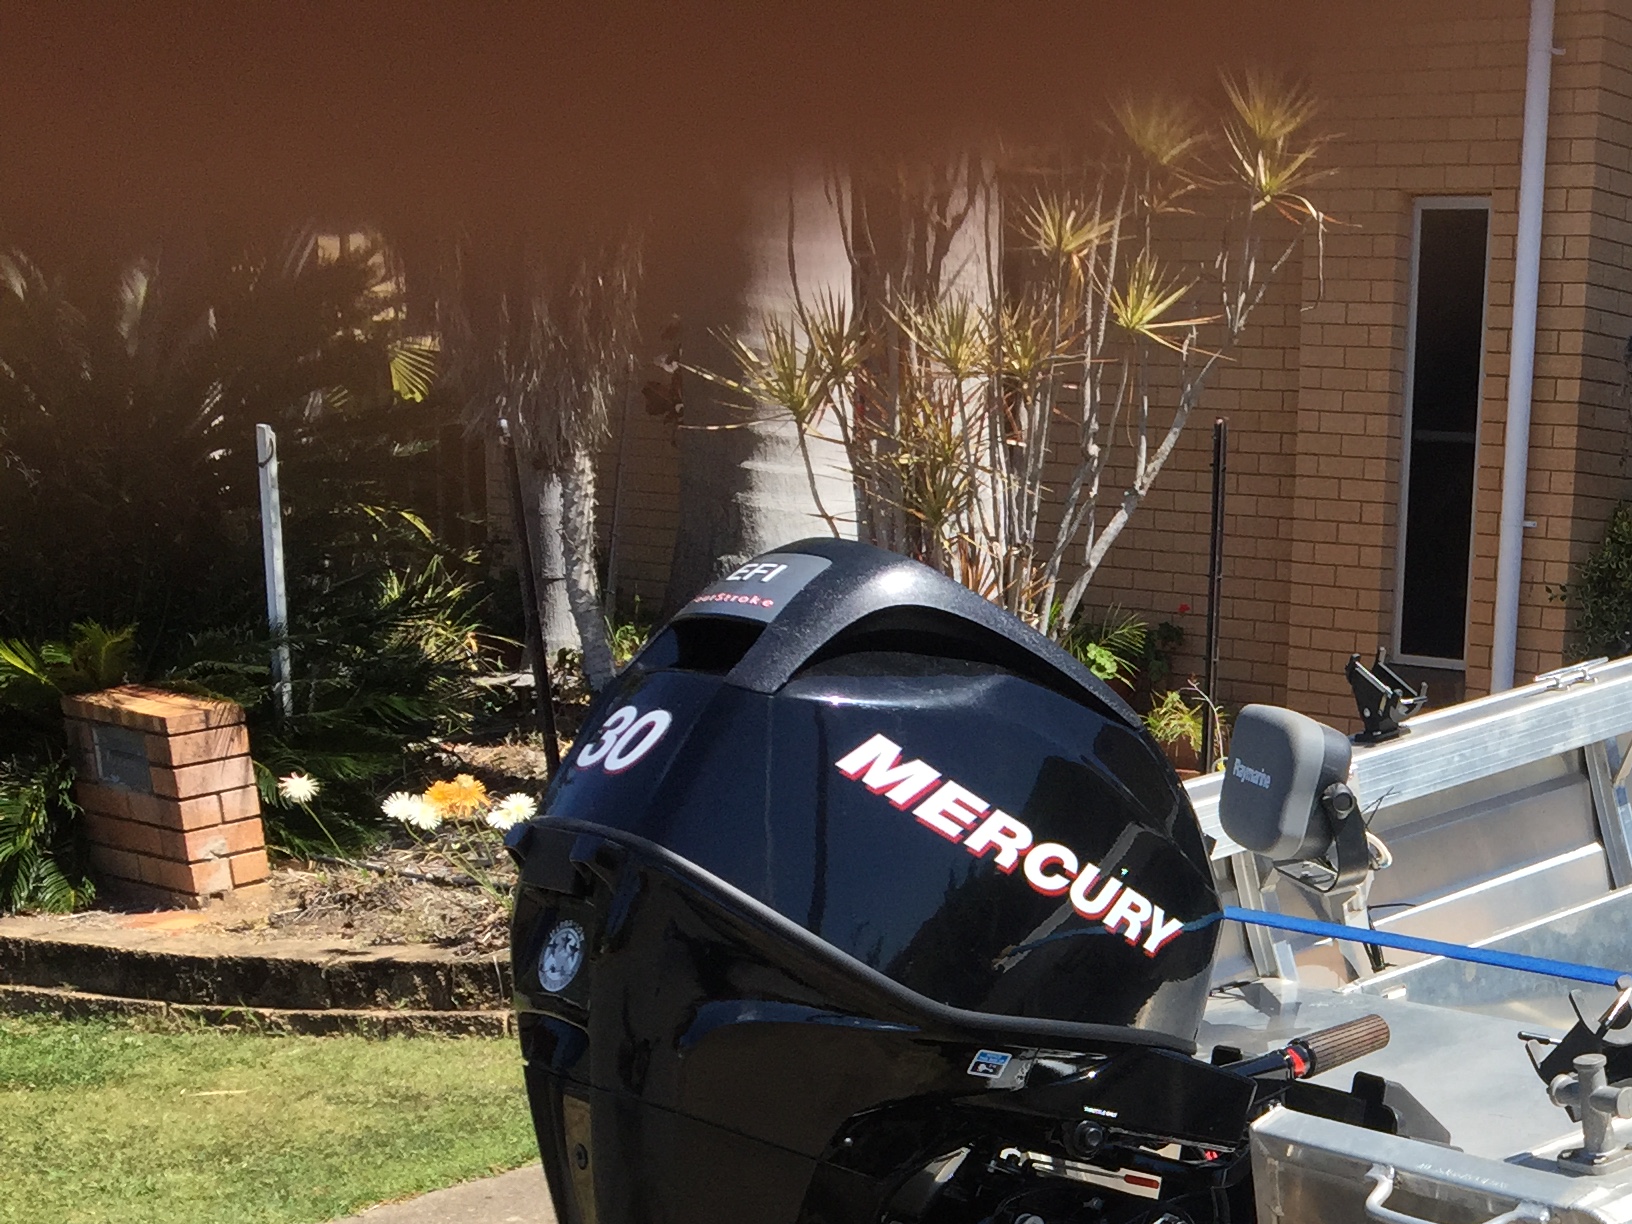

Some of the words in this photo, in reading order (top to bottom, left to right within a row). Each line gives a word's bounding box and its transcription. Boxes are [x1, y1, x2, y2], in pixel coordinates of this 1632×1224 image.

[726, 562, 788, 582] EFI
[576, 705, 672, 775] 30
[1233, 757, 1271, 790] Raymarine
[835, 733, 1184, 958] MERCURY
